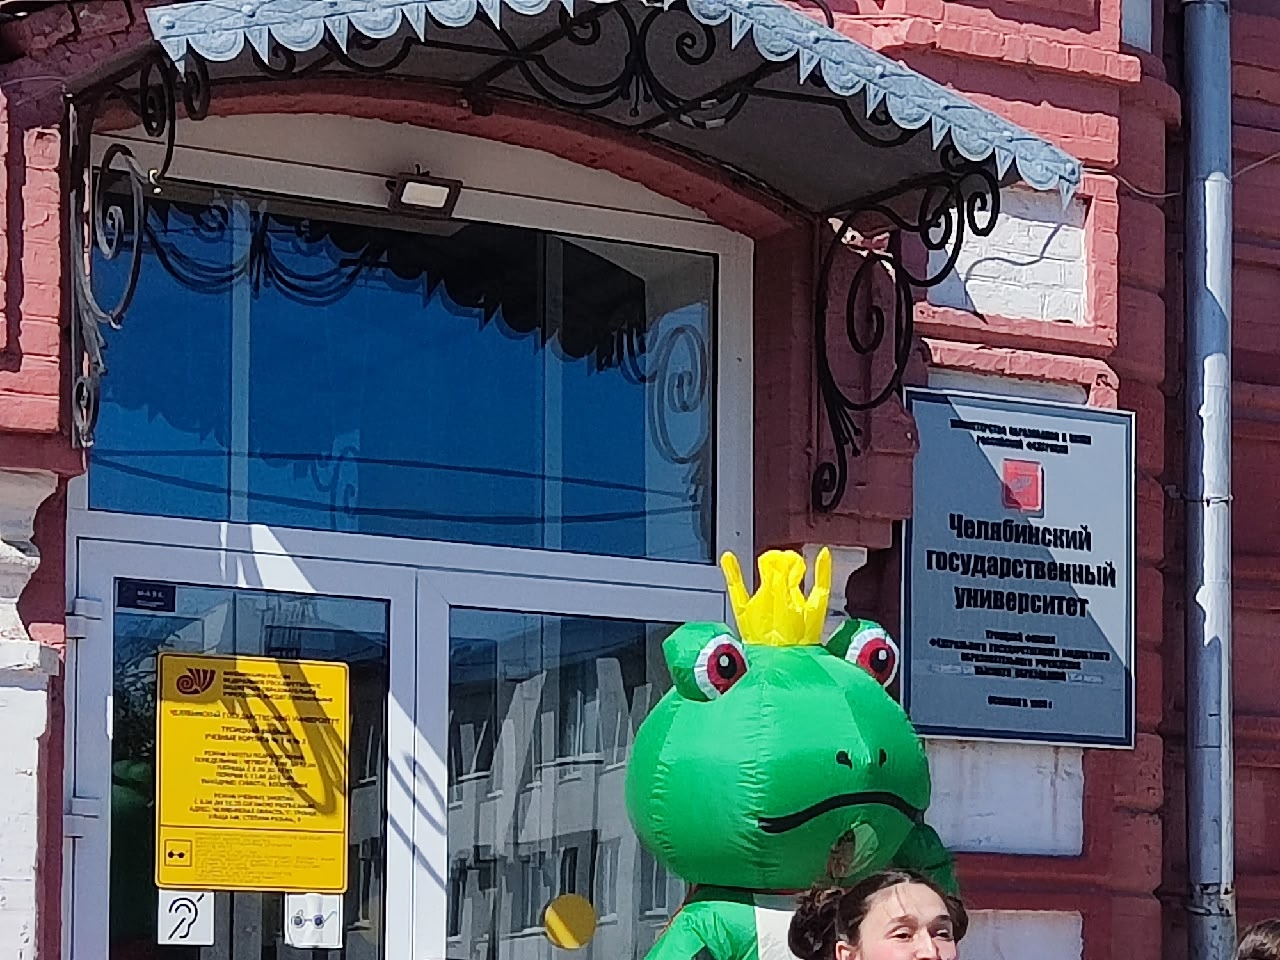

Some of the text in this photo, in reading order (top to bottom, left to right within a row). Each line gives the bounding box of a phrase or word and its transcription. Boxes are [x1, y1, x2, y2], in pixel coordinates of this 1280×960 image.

[949, 512, 1092, 552] Челябинский
[926, 549, 1116, 588] государственный
[954, 586, 1089, 617] университет
